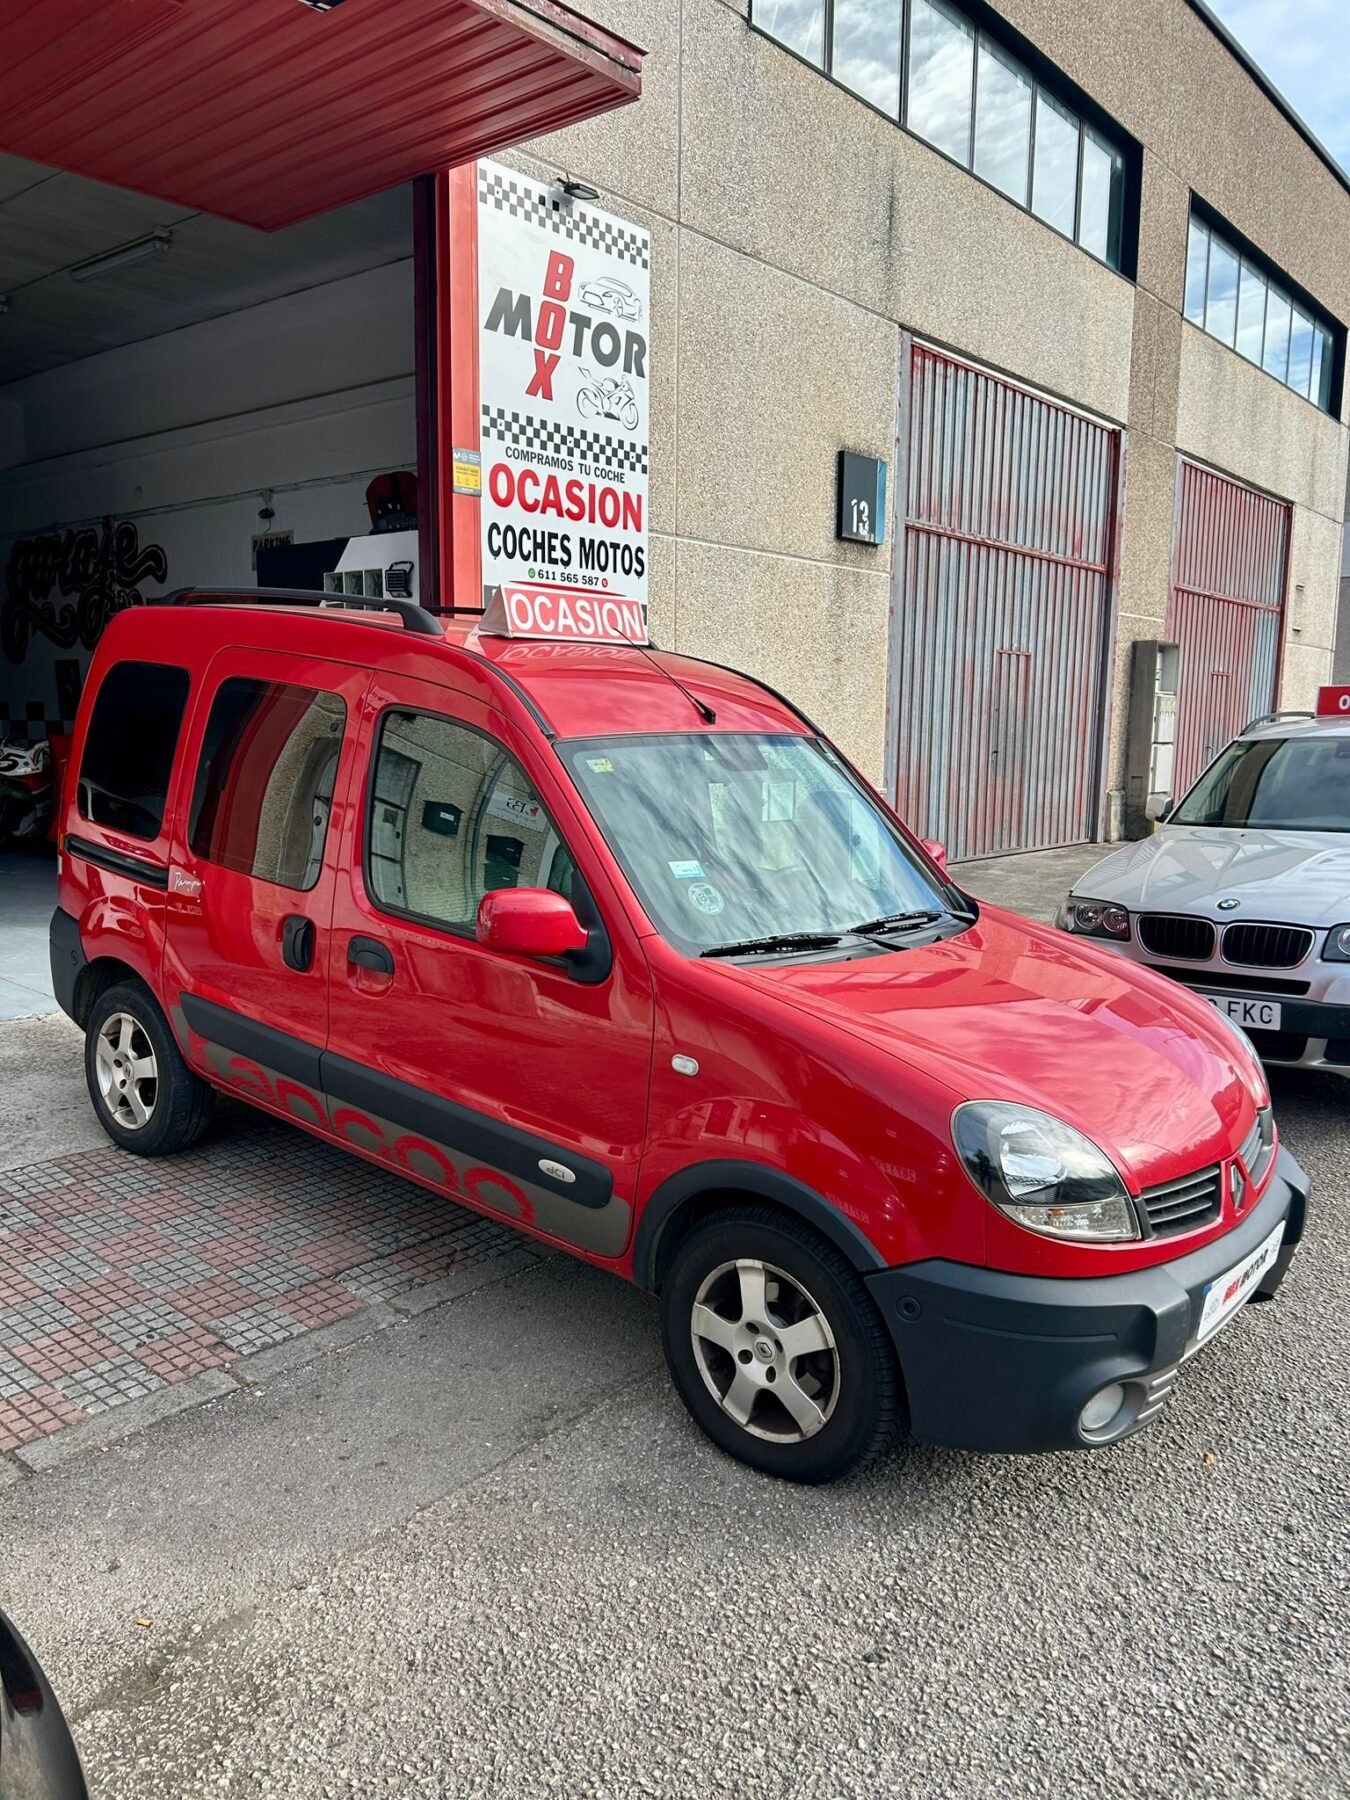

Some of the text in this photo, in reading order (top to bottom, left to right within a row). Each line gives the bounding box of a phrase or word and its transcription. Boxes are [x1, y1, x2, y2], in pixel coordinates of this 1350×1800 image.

[484, 287, 646, 379] MOTOR
[525, 249, 575, 401] BOX
[505, 446, 625, 484] COMPRAMOS TU COCHE
[489, 462, 642, 533] OCASION
[851, 498, 869, 536] 13
[487, 521, 645, 578] COCHES MOTOS
[538, 569, 599, 586] 611 565 587
[510, 592, 642, 638] OCASION
